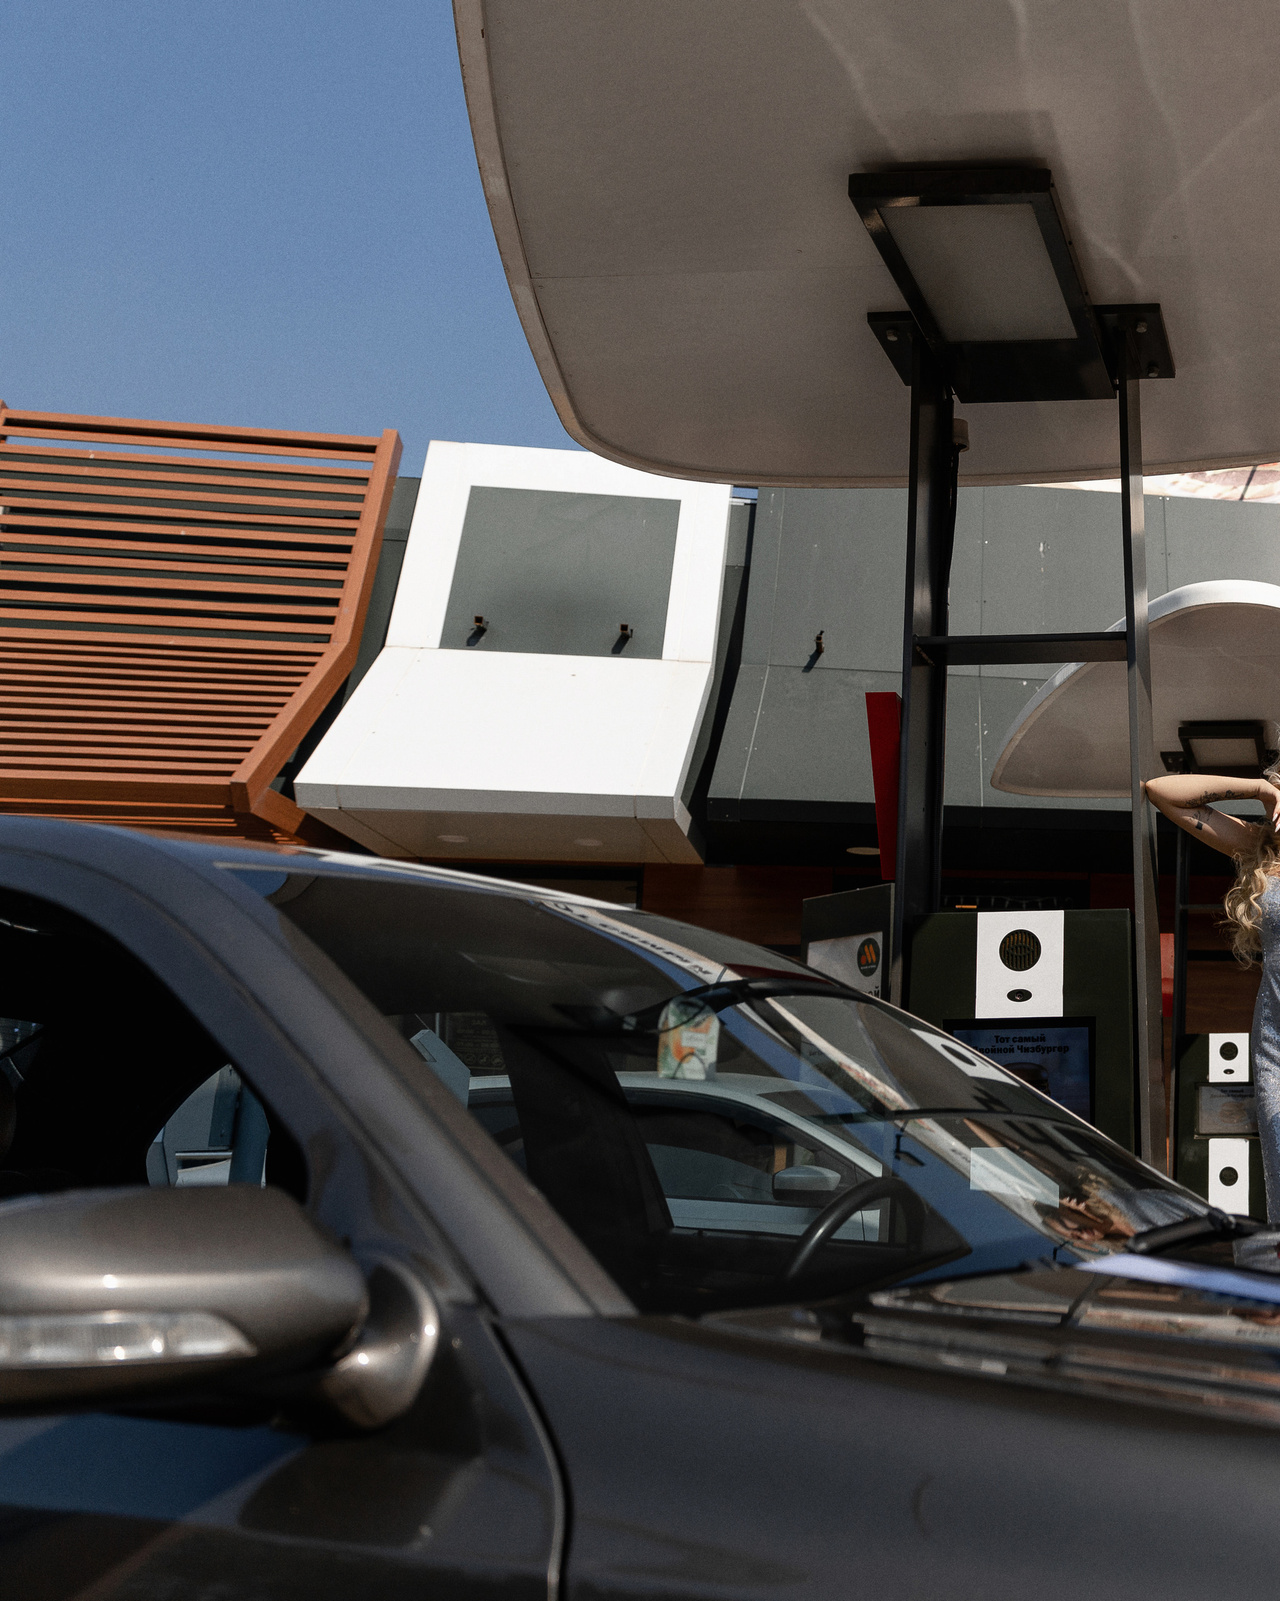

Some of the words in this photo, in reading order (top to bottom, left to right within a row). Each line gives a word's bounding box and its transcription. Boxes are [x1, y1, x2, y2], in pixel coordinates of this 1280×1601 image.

[994, 1035, 1011, 1044] Тот
[1012, 1033, 1046, 1044] самый
[1017, 1044, 1069, 1054] Чизбургер
